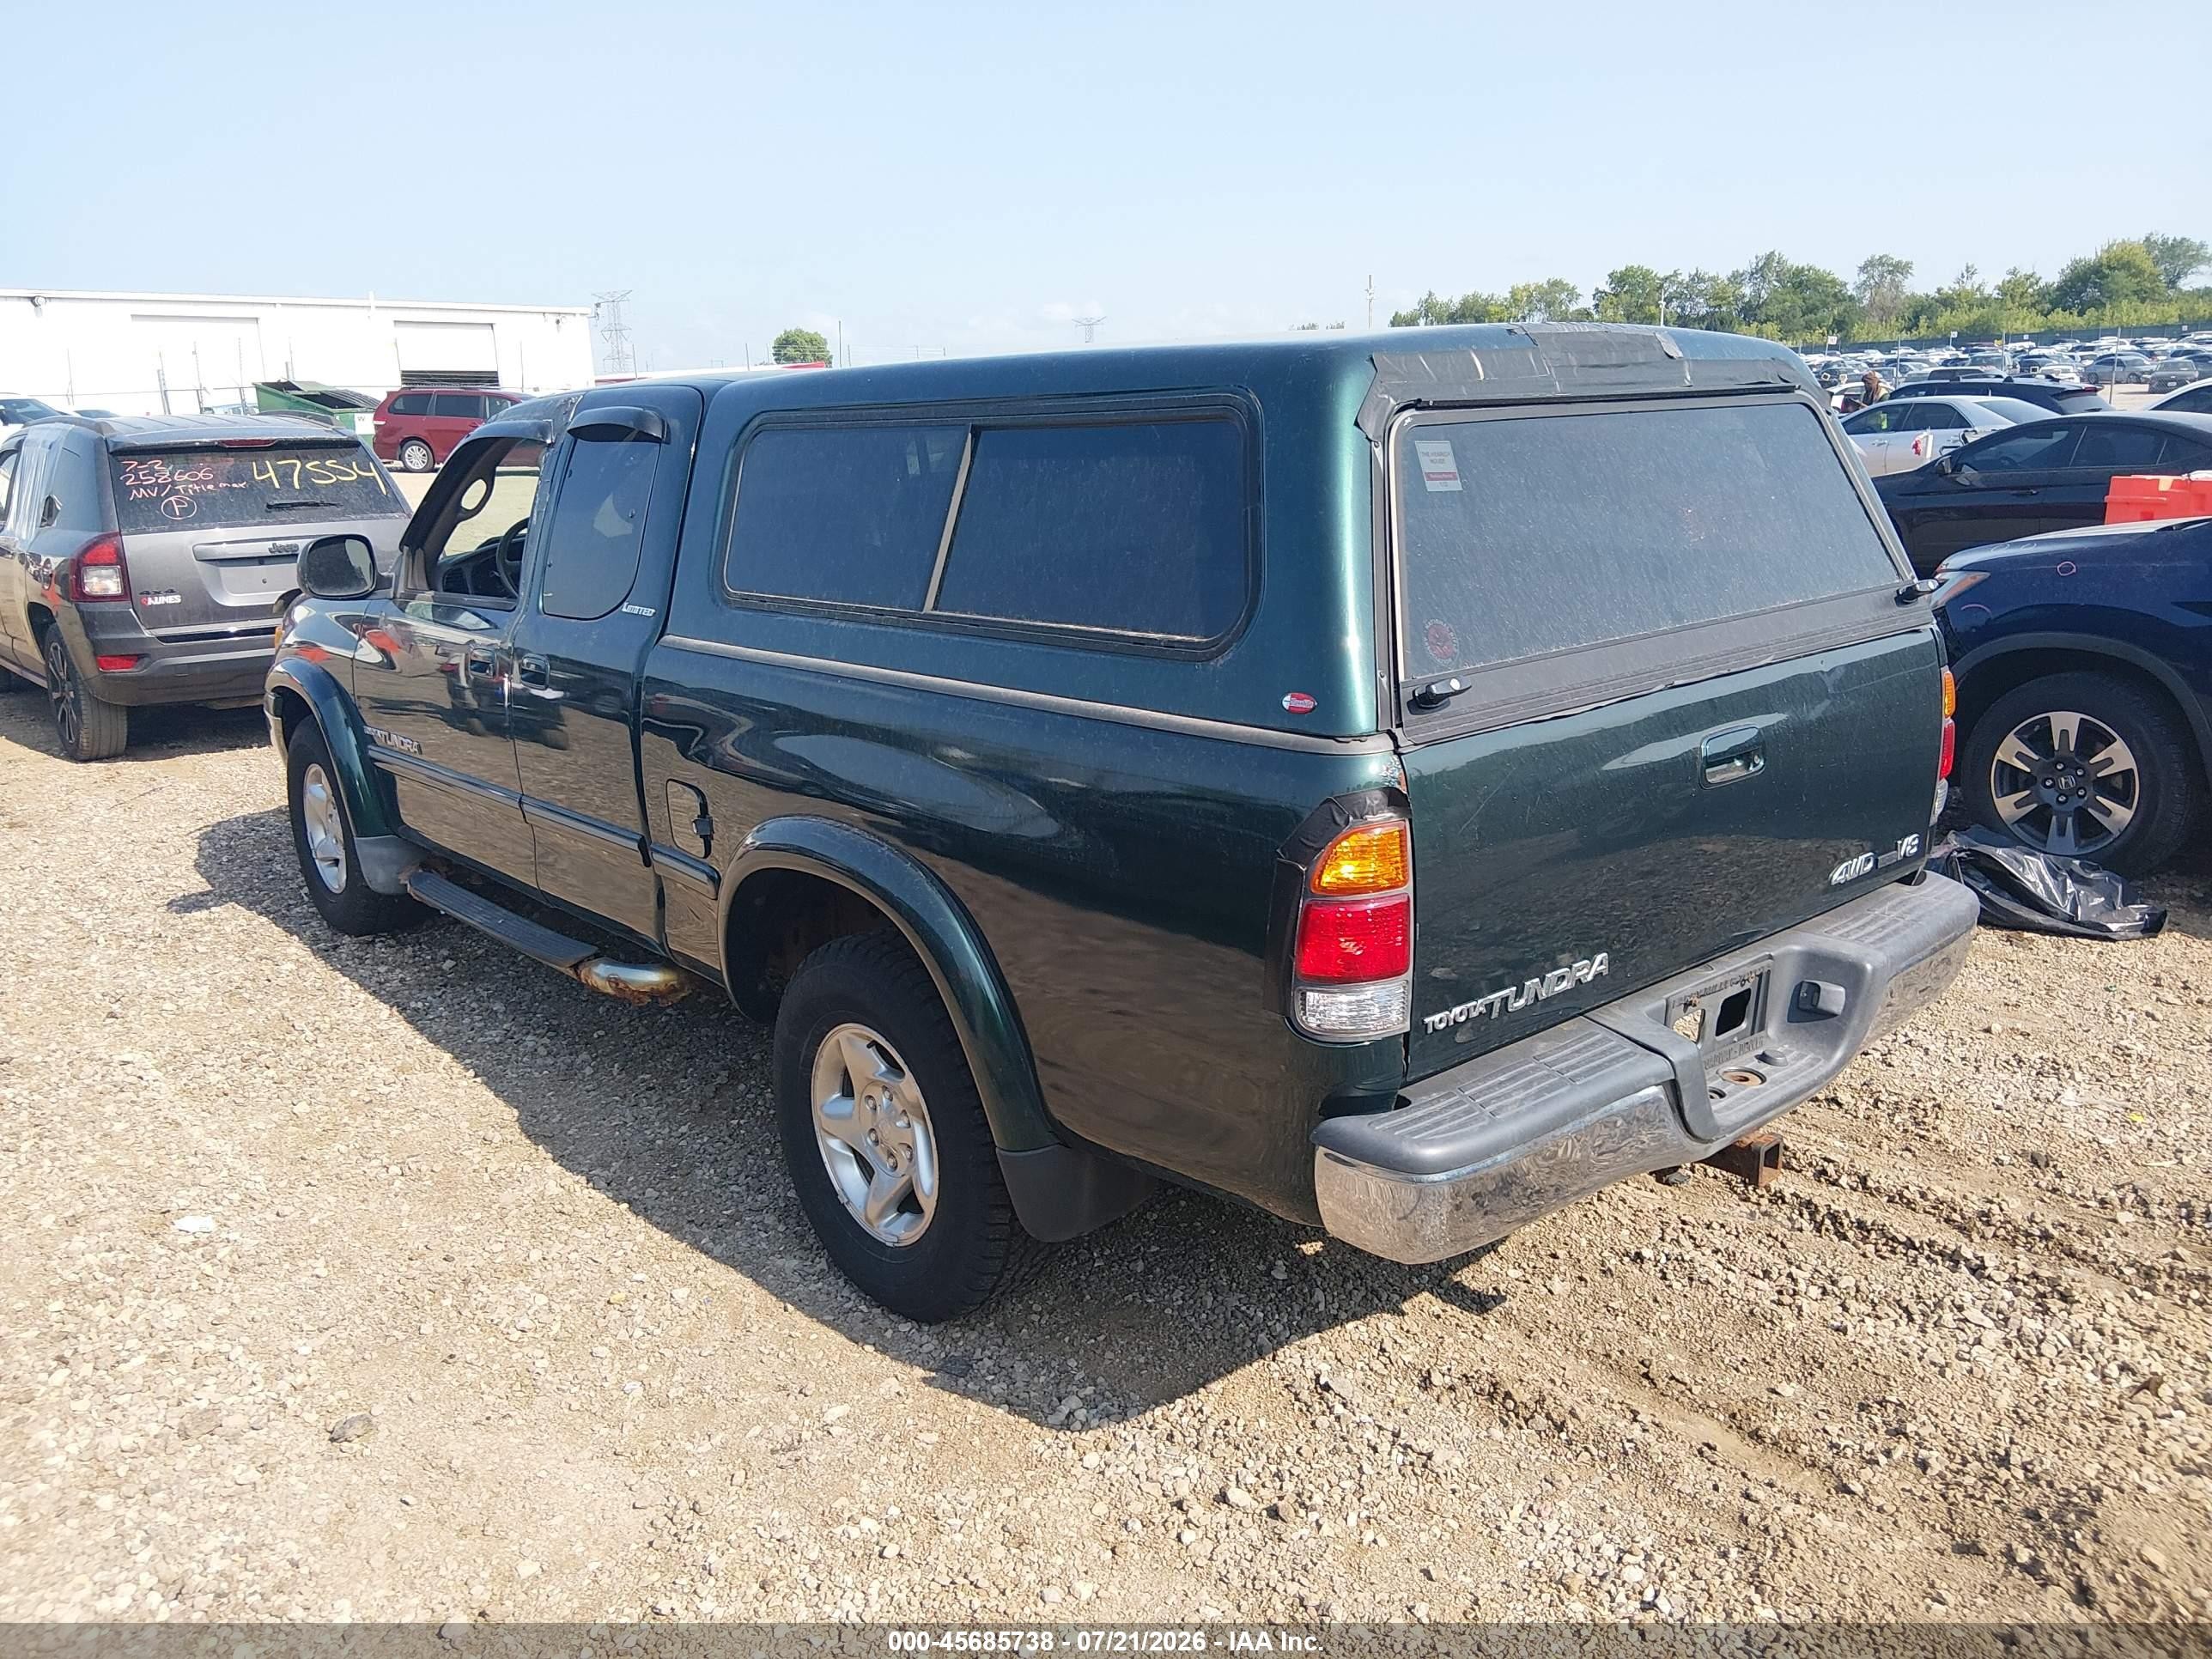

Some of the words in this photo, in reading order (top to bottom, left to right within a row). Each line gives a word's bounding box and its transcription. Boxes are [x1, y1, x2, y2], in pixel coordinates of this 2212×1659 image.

[120, 467, 214, 485] 258606
[268, 543, 300, 554] Jeep
[1423, 1000, 1486, 1035] TOYOTA
[1484, 952, 1609, 1020] TUNDRA
